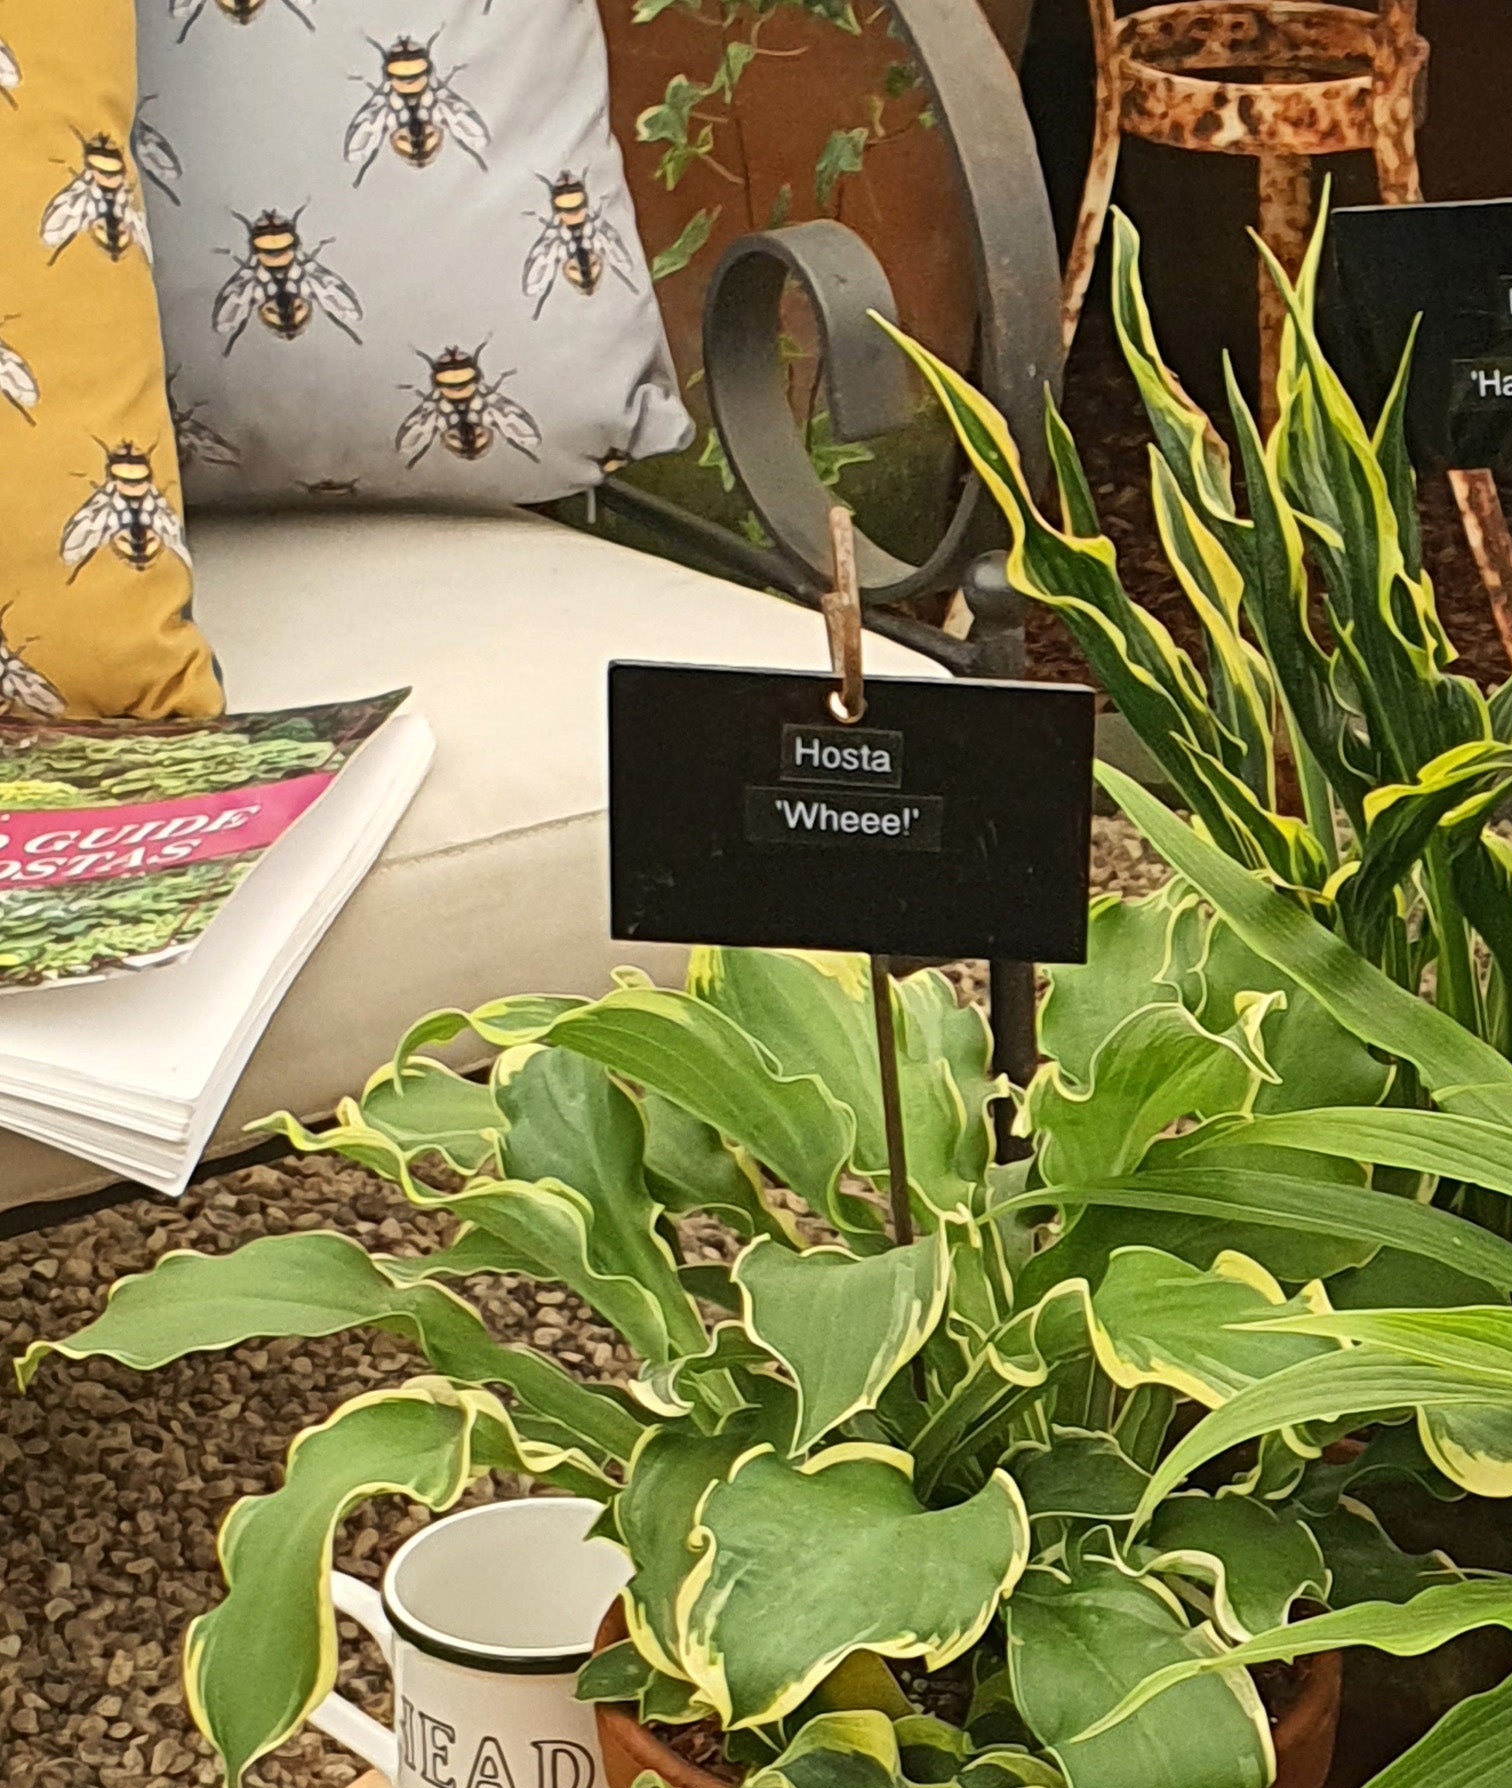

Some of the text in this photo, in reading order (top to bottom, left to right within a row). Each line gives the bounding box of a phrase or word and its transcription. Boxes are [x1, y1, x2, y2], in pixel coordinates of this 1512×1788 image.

[795, 736, 892, 773] Hosta
[24, 805, 262, 854] GUIDE
[775, 800, 919, 836] 'Wheee!'
